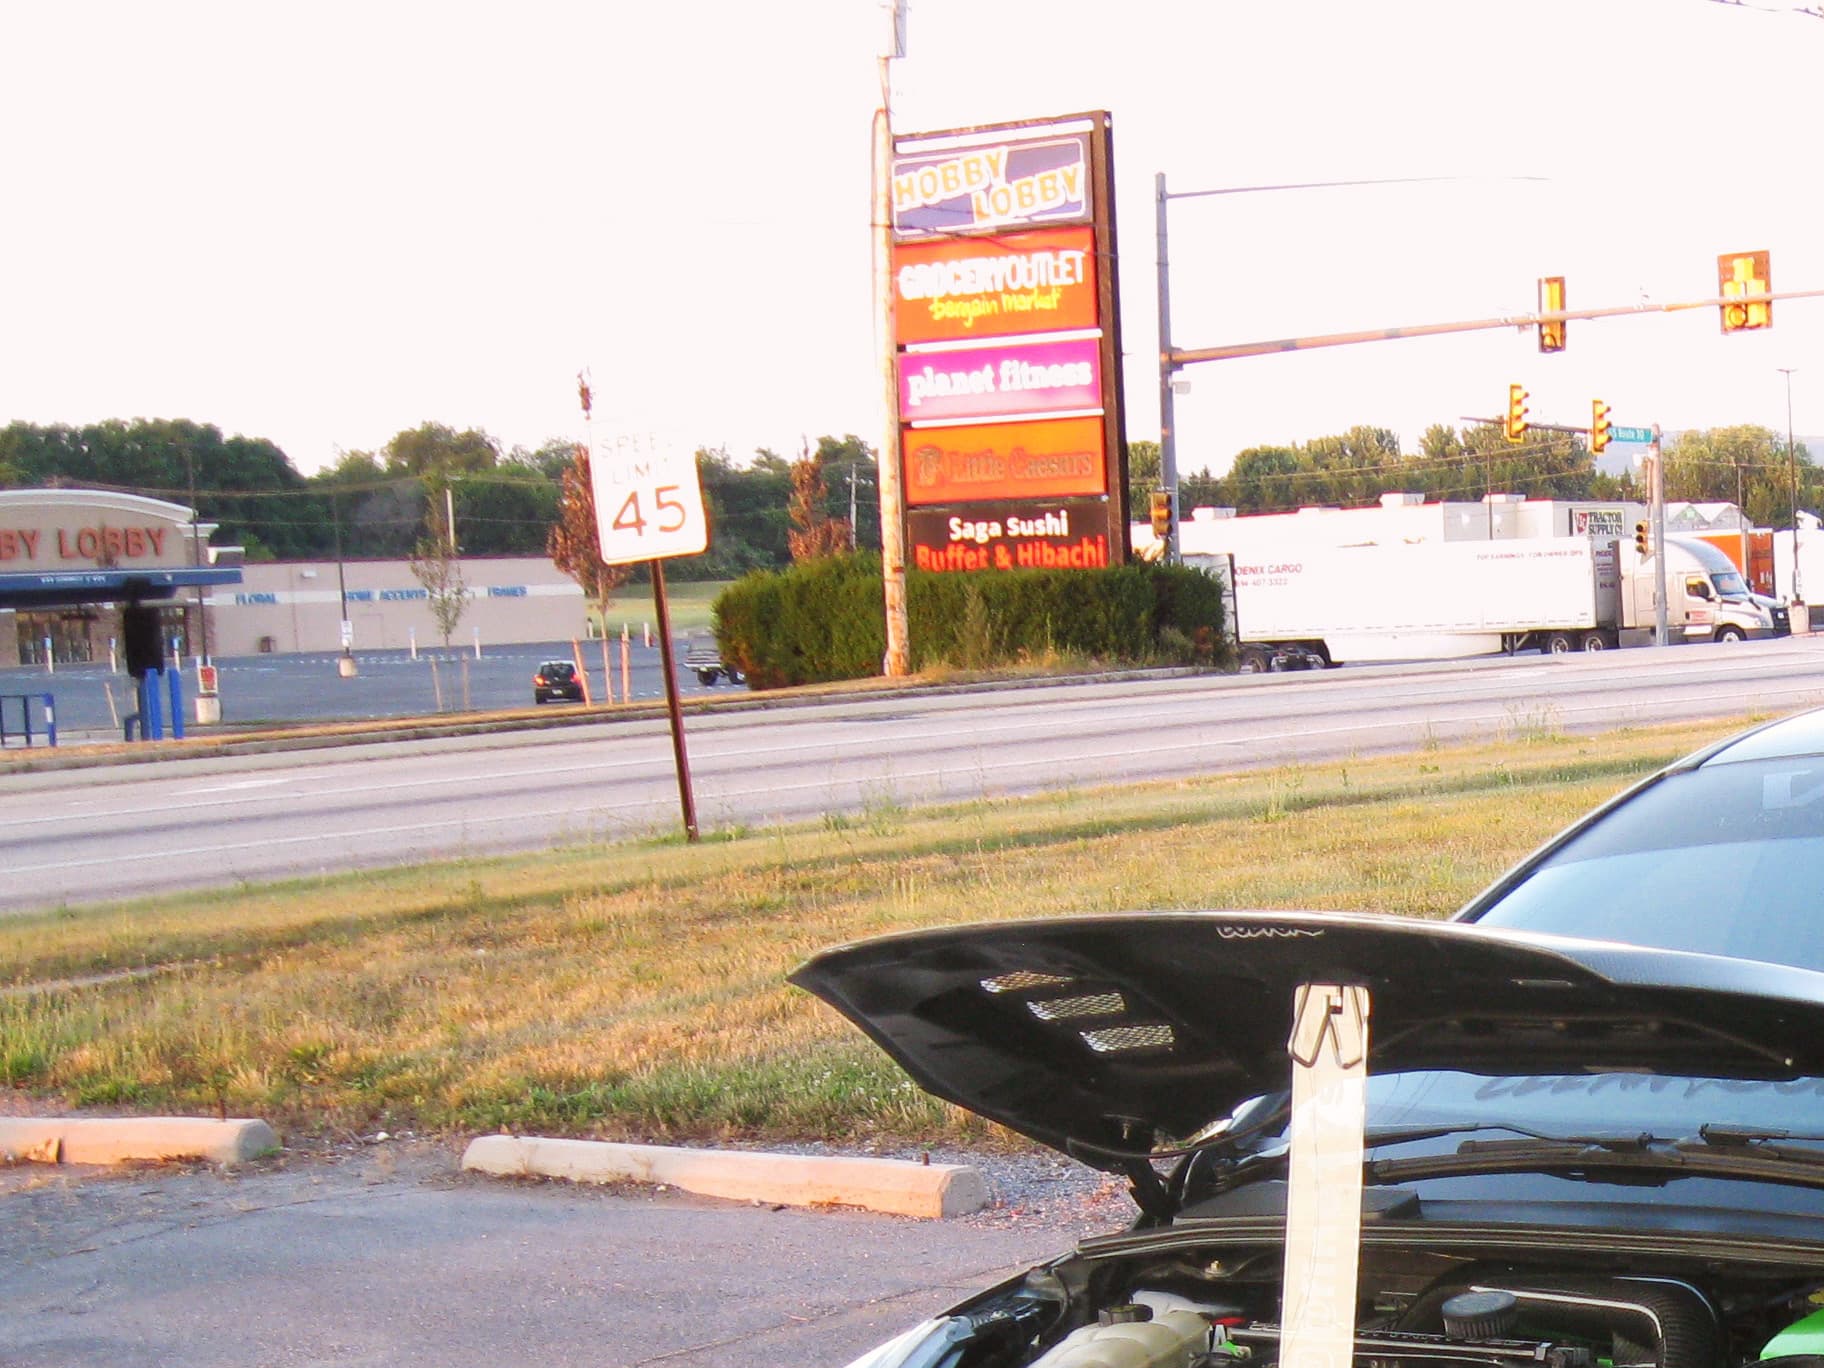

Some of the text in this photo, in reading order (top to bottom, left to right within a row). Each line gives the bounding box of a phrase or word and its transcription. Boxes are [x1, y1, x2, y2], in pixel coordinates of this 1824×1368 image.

[893, 148, 1007, 210] HOBBY
[973, 162, 1083, 222] LOBBY
[907, 359, 1093, 406] planet fitness
[948, 447, 1094, 483] Little Caesars
[612, 484, 687, 537] 45
[949, 509, 1070, 545] Saga Sushi
[57, 527, 167, 559] LOBBY
[915, 535, 1109, 574] Buffet & Hibachi
[1267, 563, 1303, 575] CARGO
